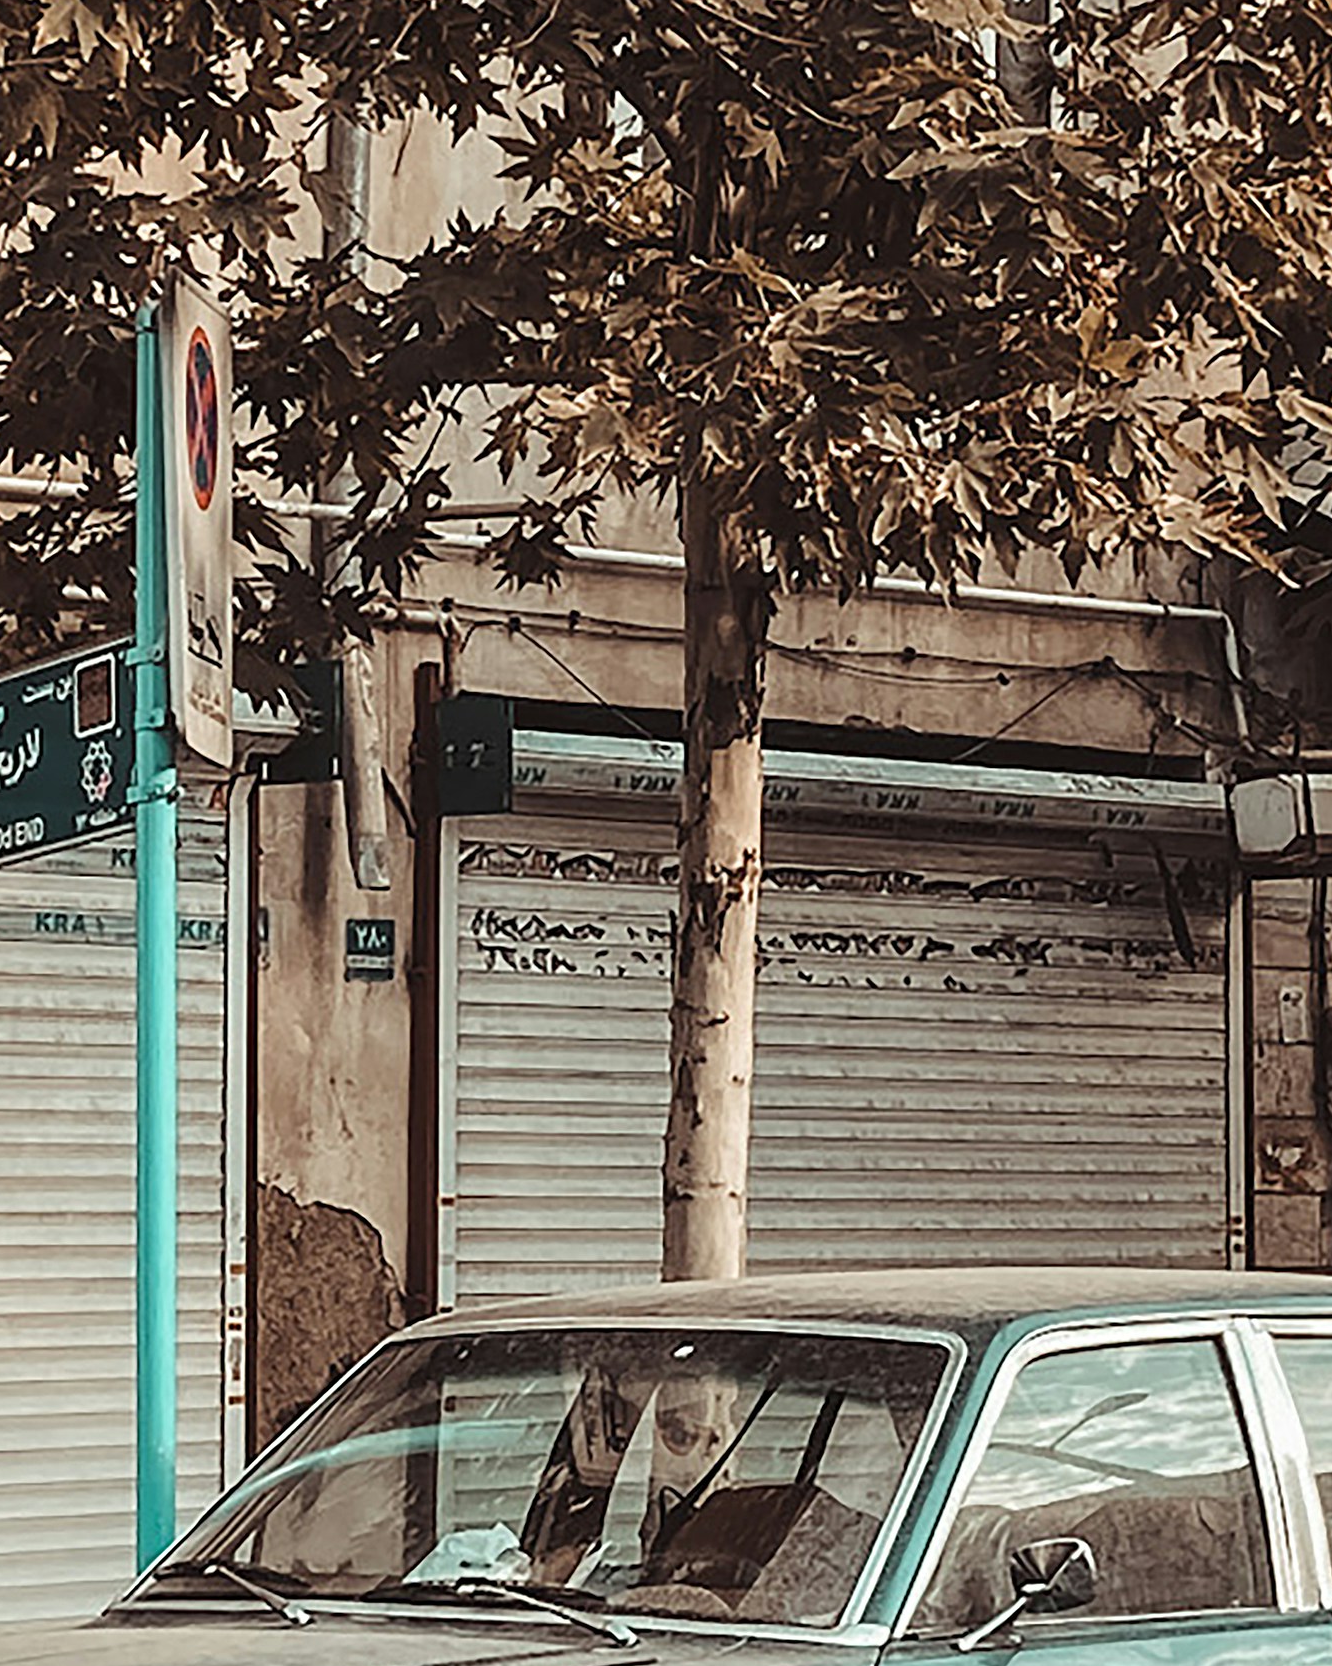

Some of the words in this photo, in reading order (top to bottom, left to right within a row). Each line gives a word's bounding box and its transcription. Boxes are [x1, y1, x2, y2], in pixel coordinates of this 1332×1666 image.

[16, 816, 44, 846] END
[35, 912, 87, 935] KRA
[354, 925, 387, 950] ۲۸۰
